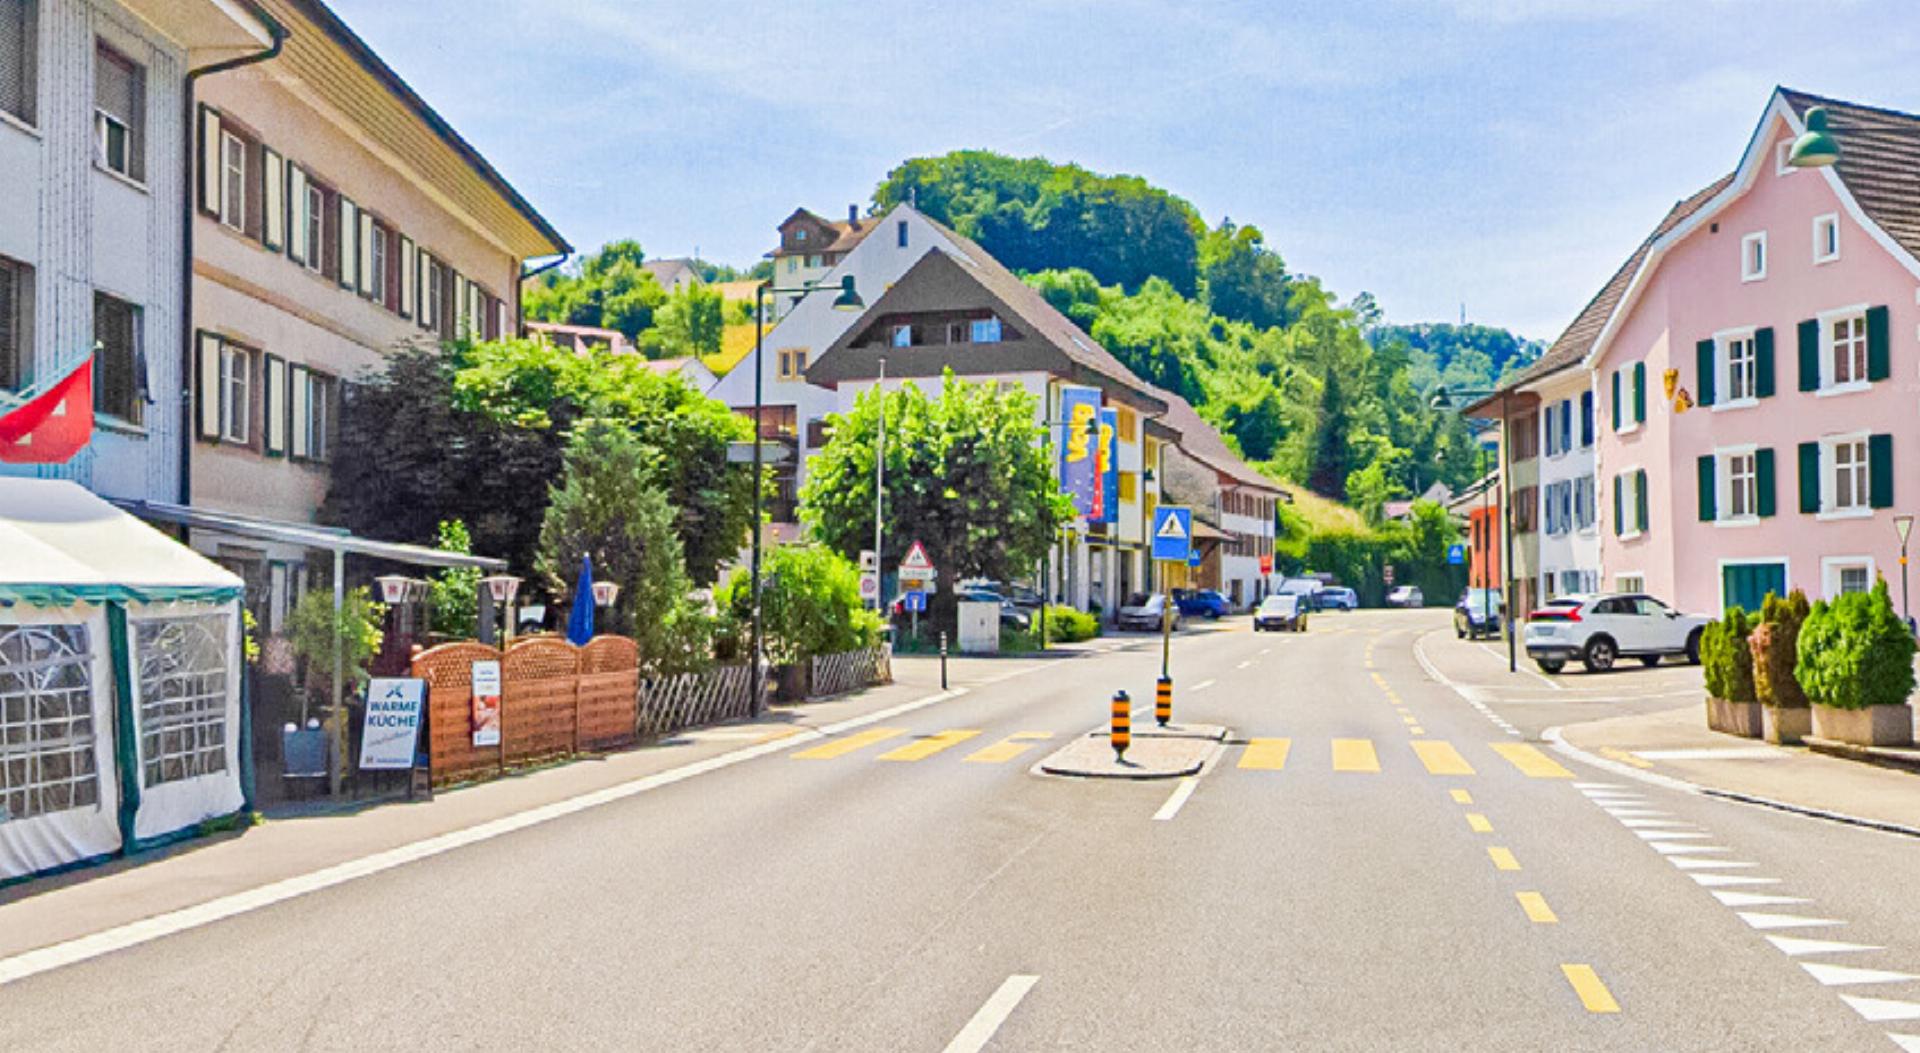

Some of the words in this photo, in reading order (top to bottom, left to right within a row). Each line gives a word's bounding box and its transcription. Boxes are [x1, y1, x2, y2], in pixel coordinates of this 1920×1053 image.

[1066, 403, 1094, 463] Volg
[370, 701, 418, 711] WARME
[367, 714, 417, 727] KÜCHE
